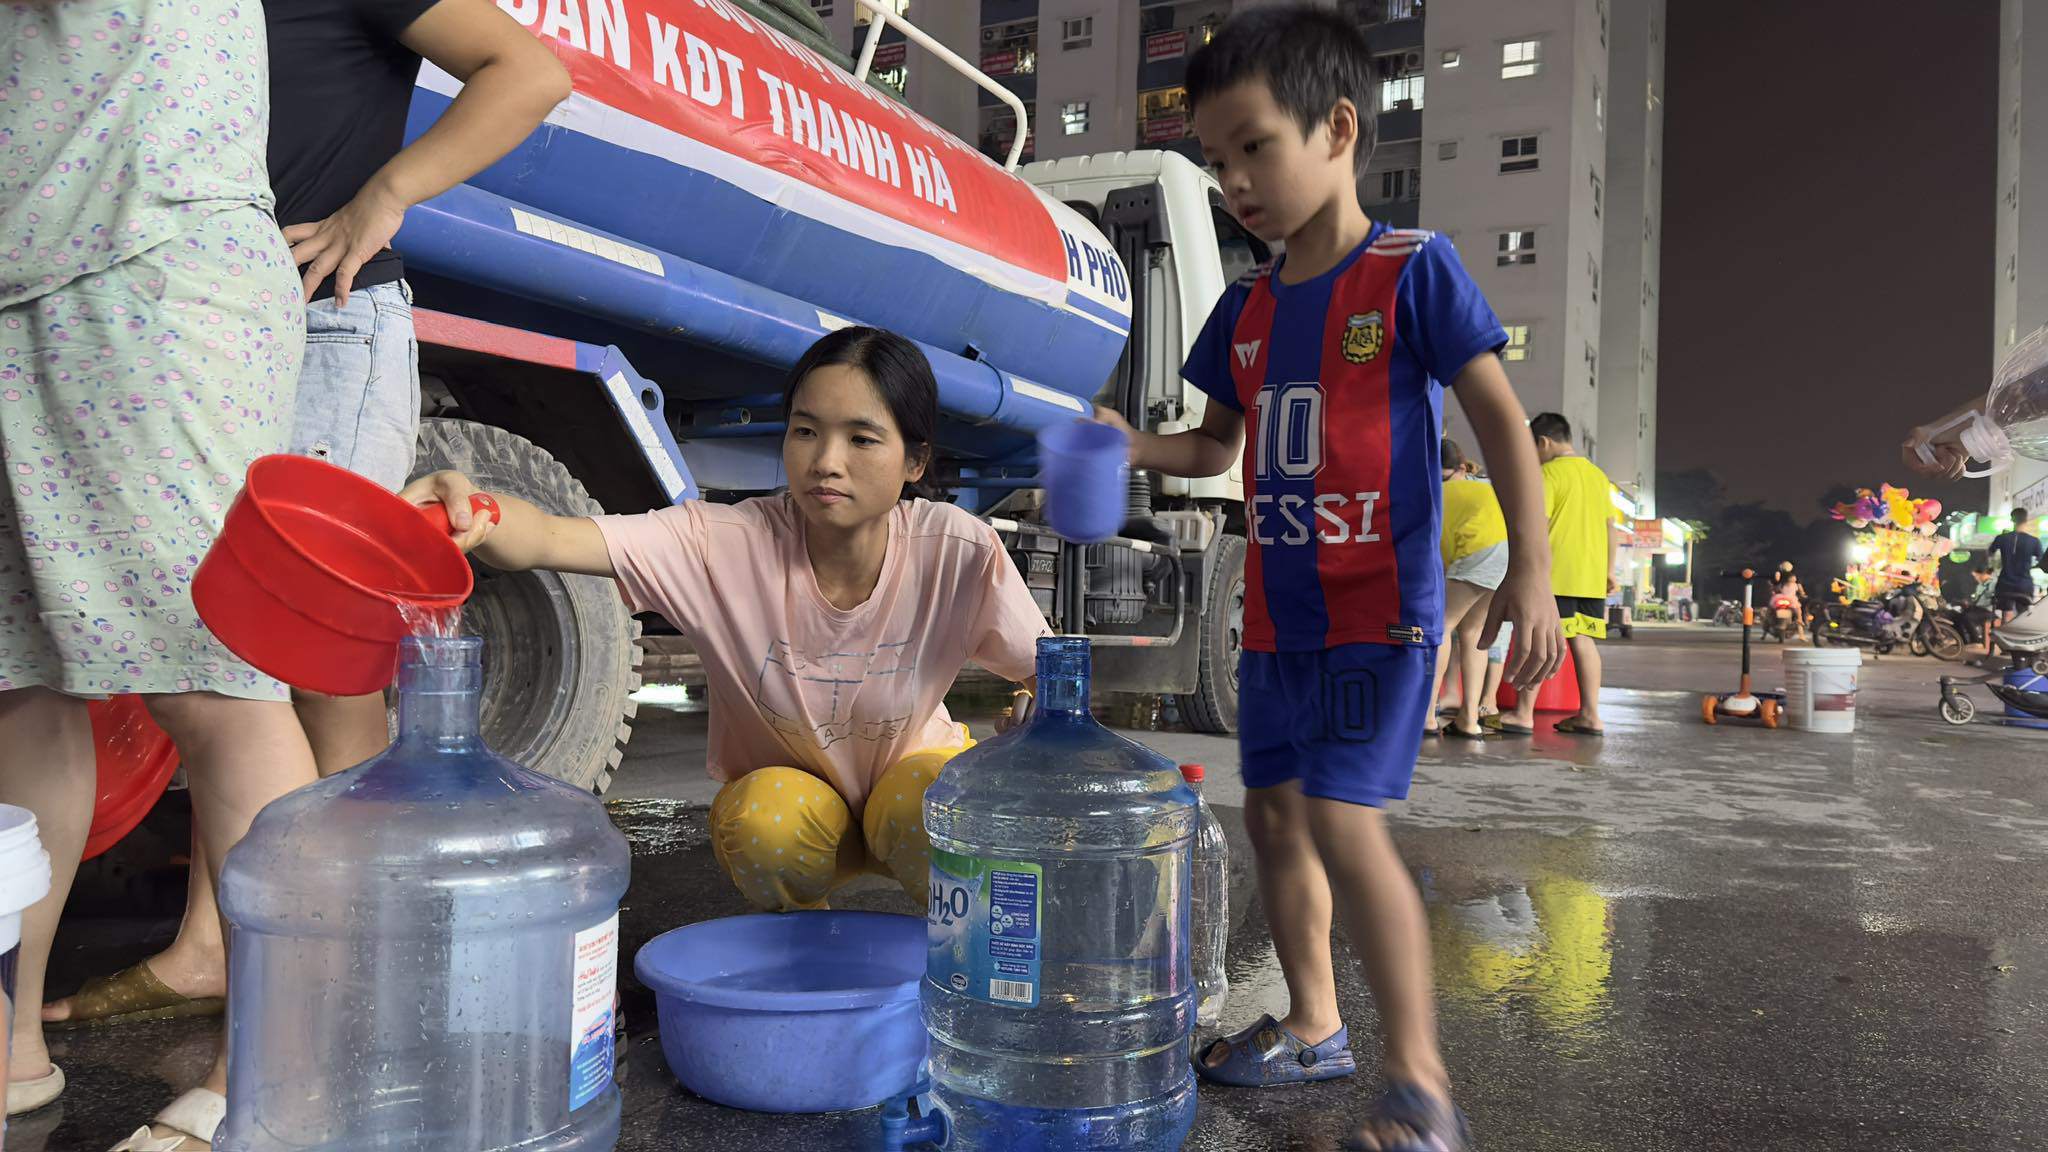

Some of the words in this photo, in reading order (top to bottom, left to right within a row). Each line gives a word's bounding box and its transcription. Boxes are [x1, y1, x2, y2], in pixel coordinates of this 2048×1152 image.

[646, 12, 744, 120] KĐT
[757, 68, 901, 188] THANH
[902, 141, 957, 213] HÀ
[1252, 381, 1327, 481] 10
